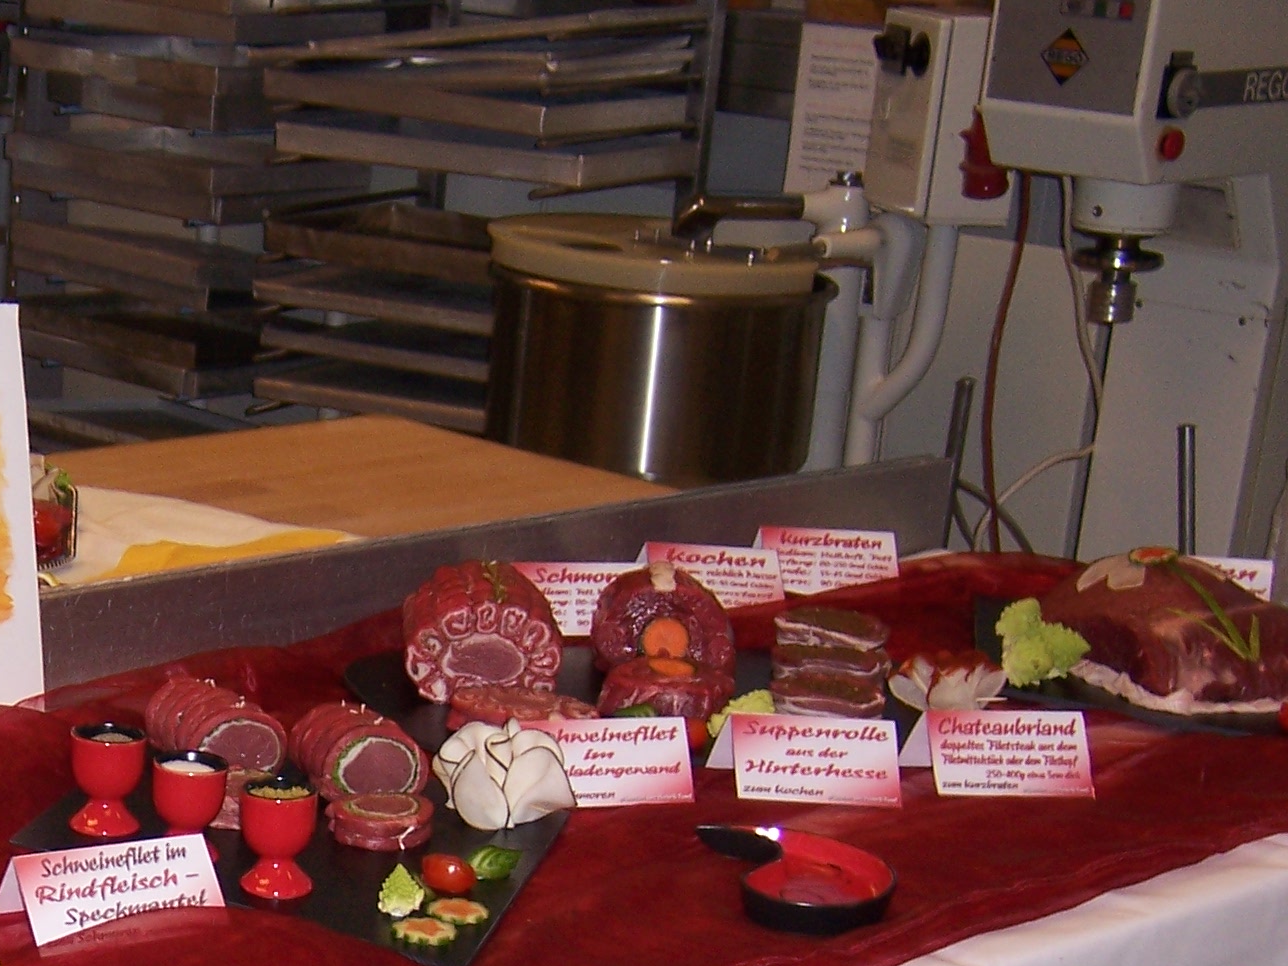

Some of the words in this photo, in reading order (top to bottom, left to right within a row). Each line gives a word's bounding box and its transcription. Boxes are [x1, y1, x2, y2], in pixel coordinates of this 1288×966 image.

[534, 567, 616, 583] Schmor
[554, 726, 678, 746] hweinefilet
[742, 720, 889, 742] Suppenrolle
[938, 717, 1076, 737] Chateaubriand
[785, 748, 813, 757] aus
[818, 747, 848, 758] der
[566, 761, 681, 779] ladengewand
[745, 759, 888, 780] Hinterhesse
[743, 785, 771, 794] zum
[41, 846, 160, 878] Schweinefilet
[165, 843, 187, 862] im
[65, 888, 208, 927] Speckmantel
